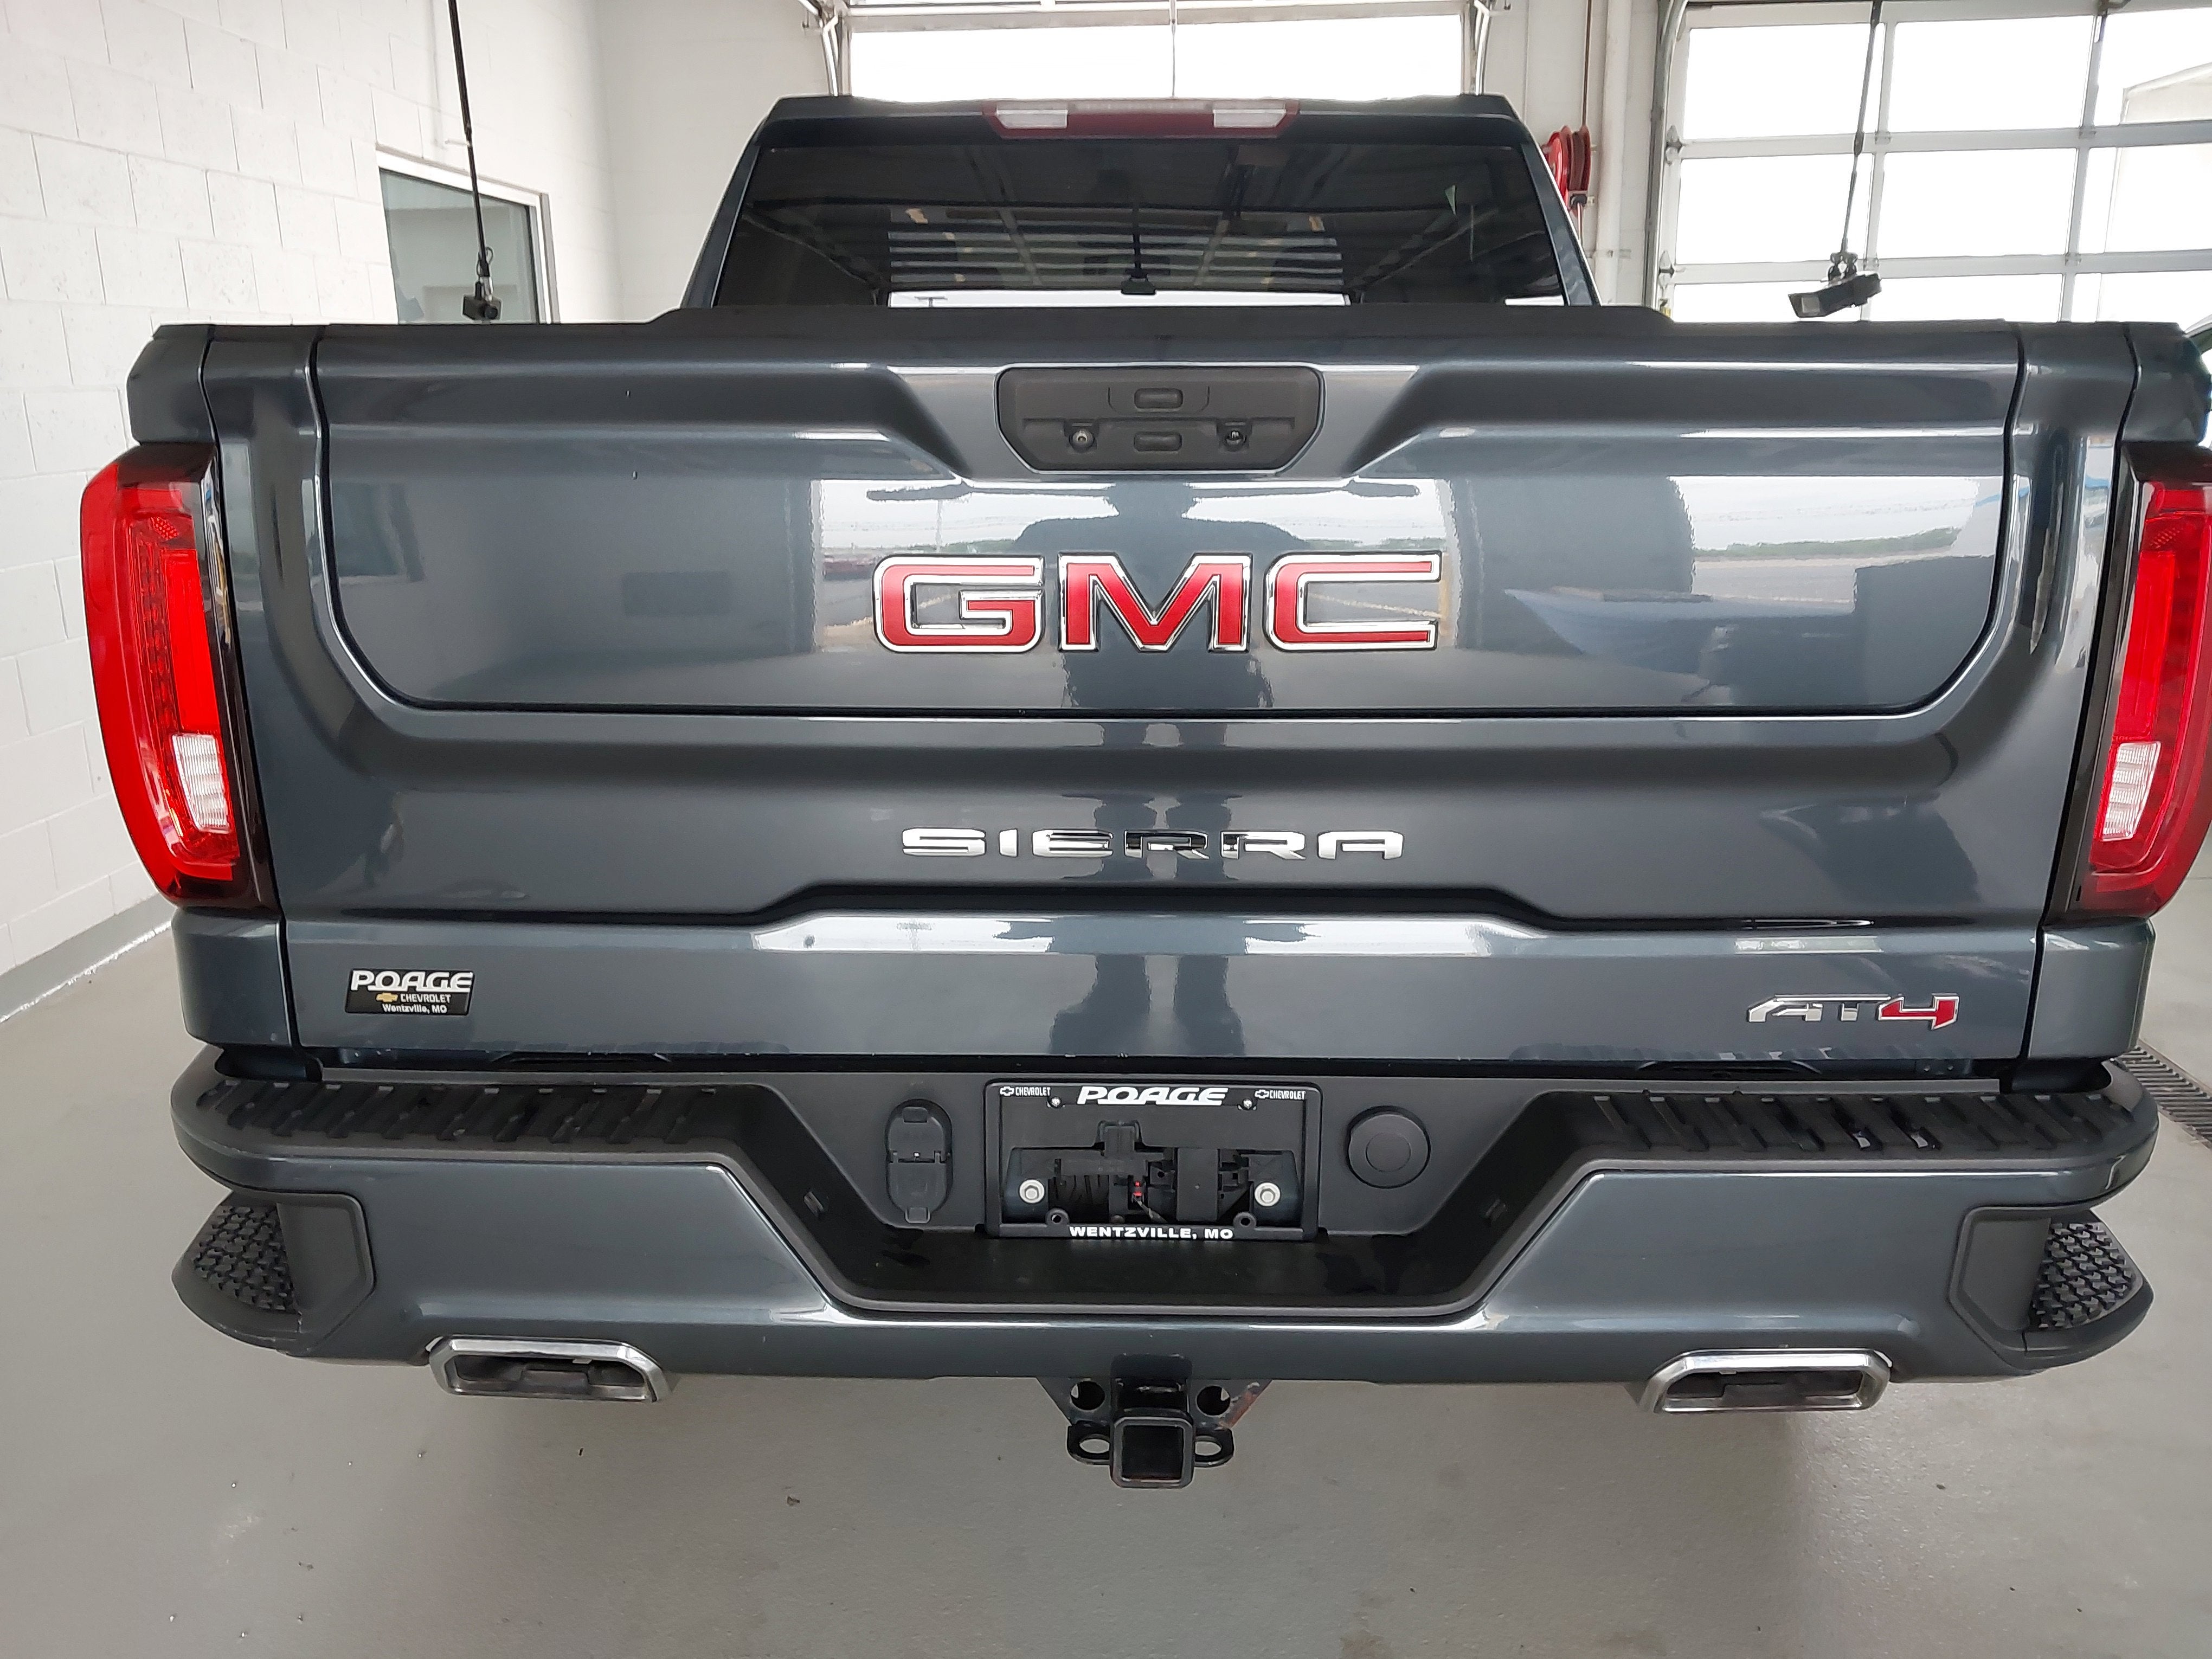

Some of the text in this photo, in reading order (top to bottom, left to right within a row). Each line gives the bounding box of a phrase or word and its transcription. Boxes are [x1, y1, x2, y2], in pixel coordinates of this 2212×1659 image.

[873, 552, 1442, 653] GMC
[902, 828, 1404, 860] SIERRA
[351, 970, 473, 993] POAGE
[400, 993, 452, 1003] CHEVROLET
[382, 1004, 447, 1014] Wentzville, MO
[1747, 993, 1960, 1031] AT4
[1015, 1086, 1051, 1096] CHEVROLET
[1077, 1086, 1229, 1105] POAGE
[1269, 1090, 1306, 1100] CHEVROLET
[1069, 1226, 1233, 1239] WENTZVILLE, MO
